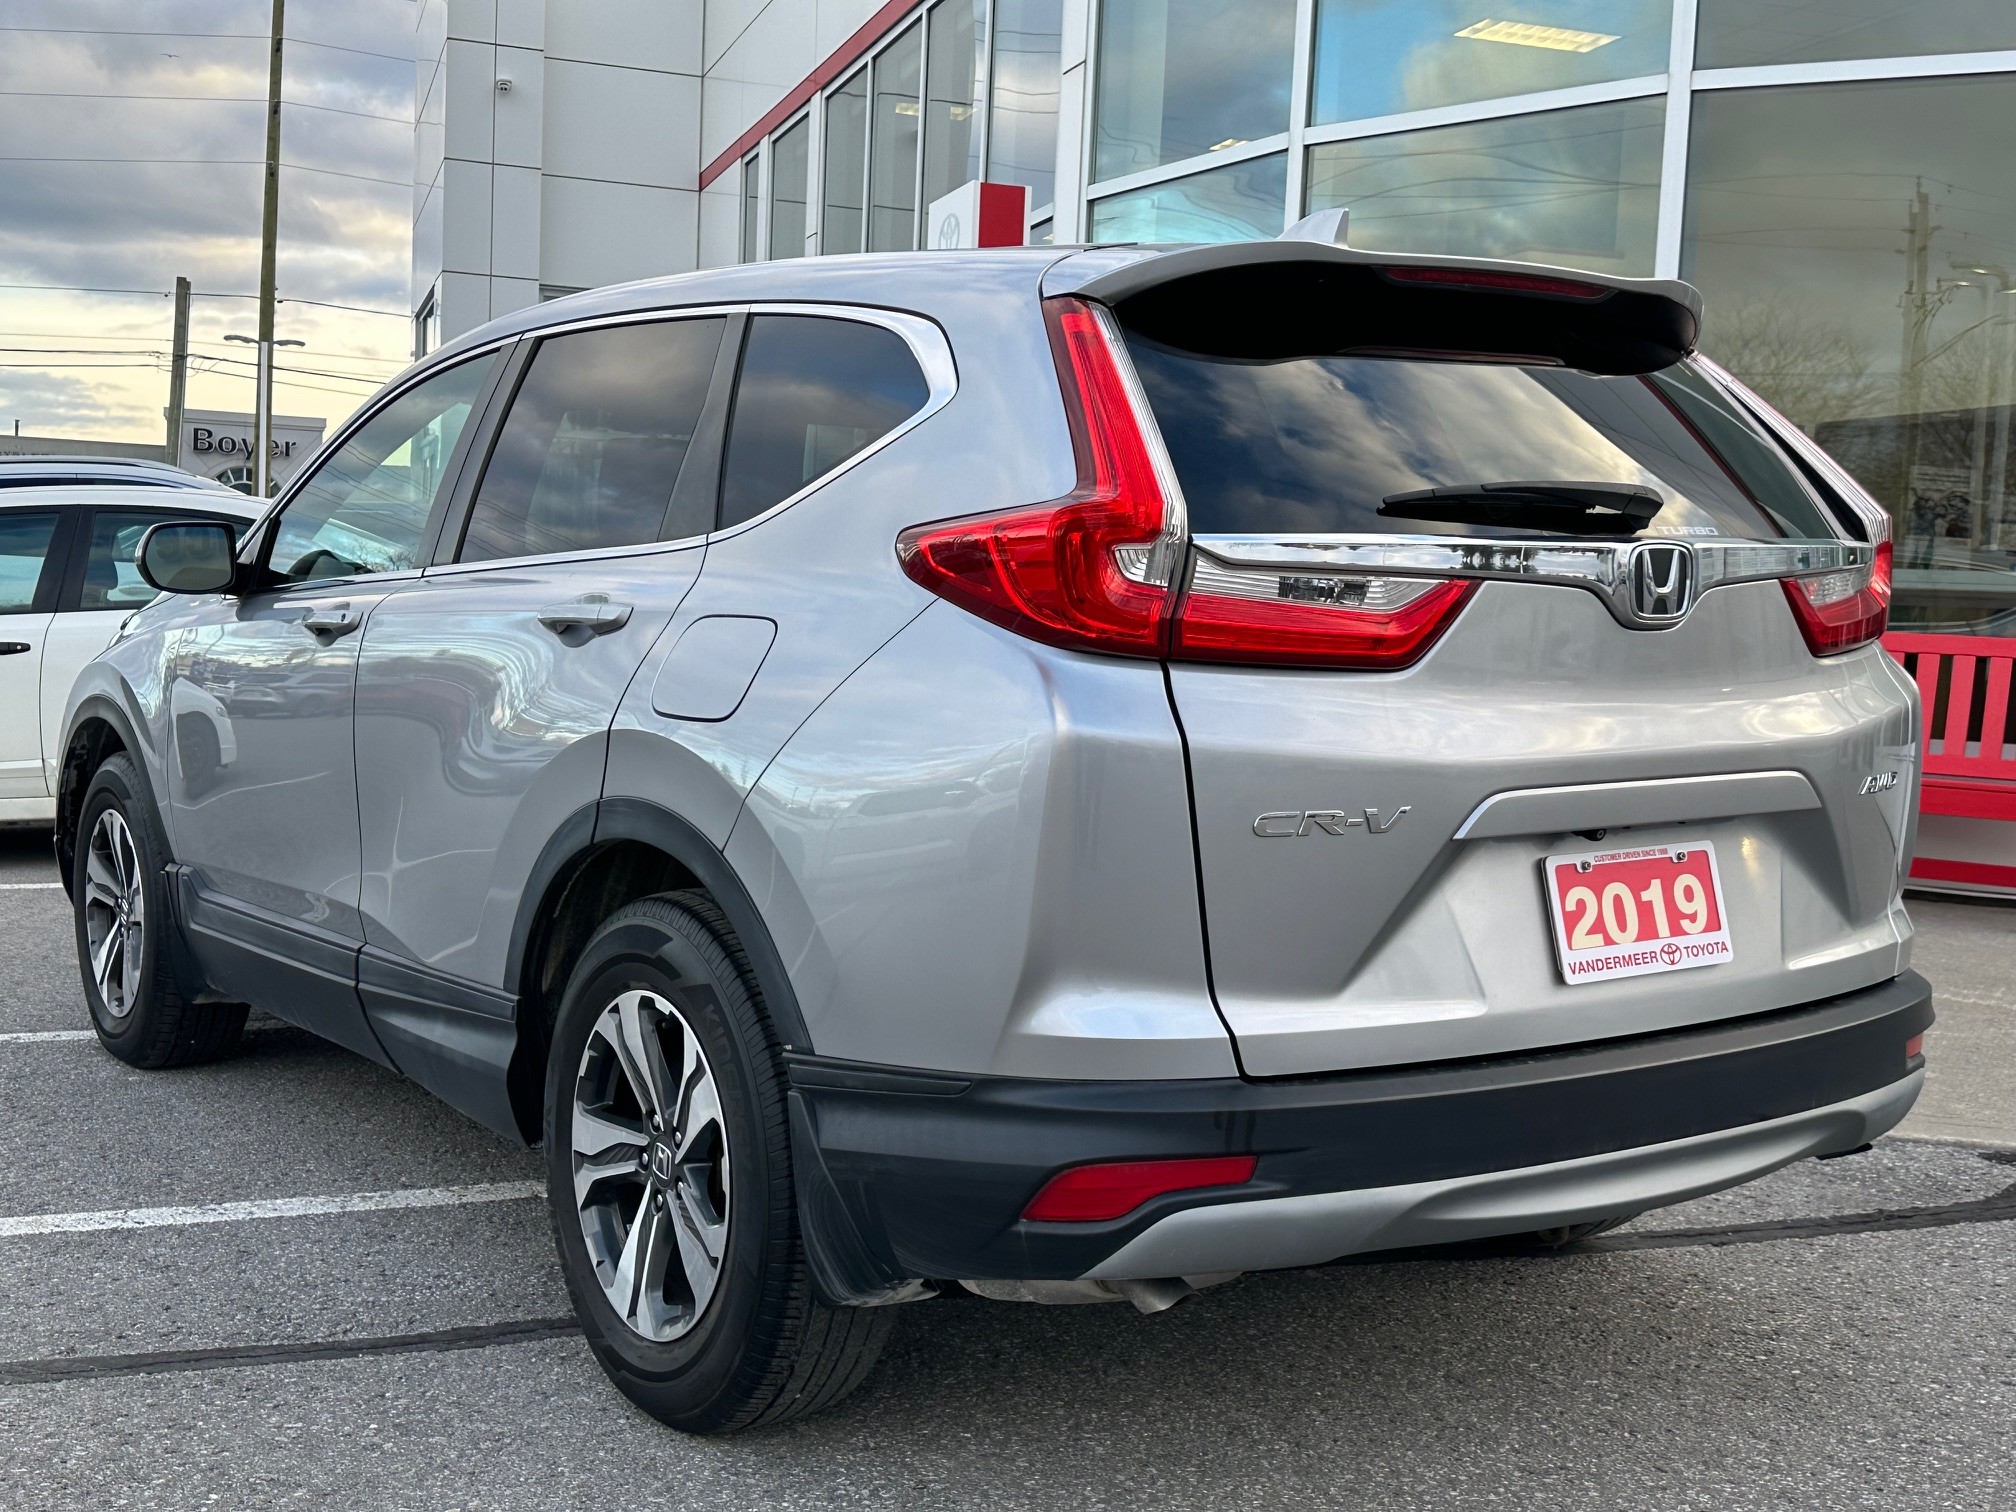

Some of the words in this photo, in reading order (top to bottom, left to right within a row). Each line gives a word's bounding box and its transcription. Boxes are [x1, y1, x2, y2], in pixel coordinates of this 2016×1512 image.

[1657, 526, 1718, 535] TURBO
[1859, 771, 1898, 795] AWD
[1253, 806, 1411, 837] CR-V
[1594, 852, 1621, 862] CUSTOMER
[1622, 850, 1641, 860] DRIVEN
[1565, 873, 1708, 949] 2019
[1568, 950, 1659, 976] VANDERMEER
[1683, 941, 1729, 959] TOYOTA
